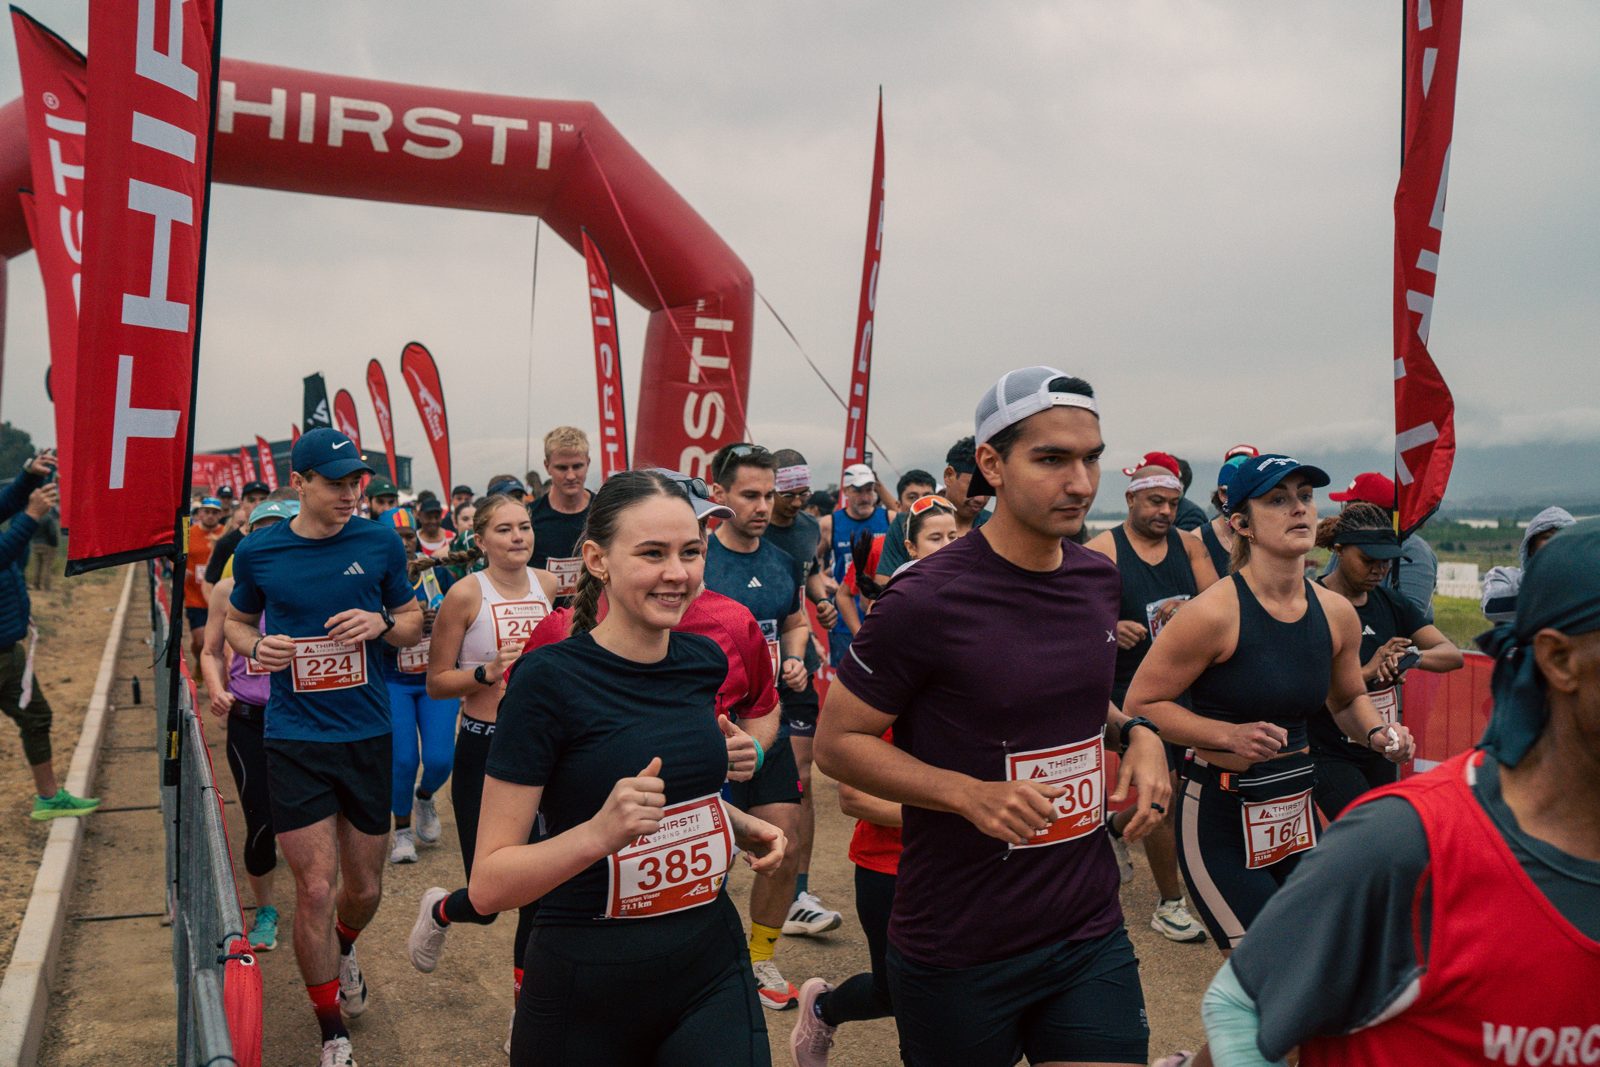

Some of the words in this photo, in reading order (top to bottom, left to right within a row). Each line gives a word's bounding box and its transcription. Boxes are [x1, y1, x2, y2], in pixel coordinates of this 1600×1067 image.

[307, 655, 353, 676] 224
[652, 831, 680, 843] SPRING
[683, 825, 701, 834] HALF
[1264, 816, 1301, 848] 160
[638, 841, 712, 890] 385
[637, 901, 652, 909] km
